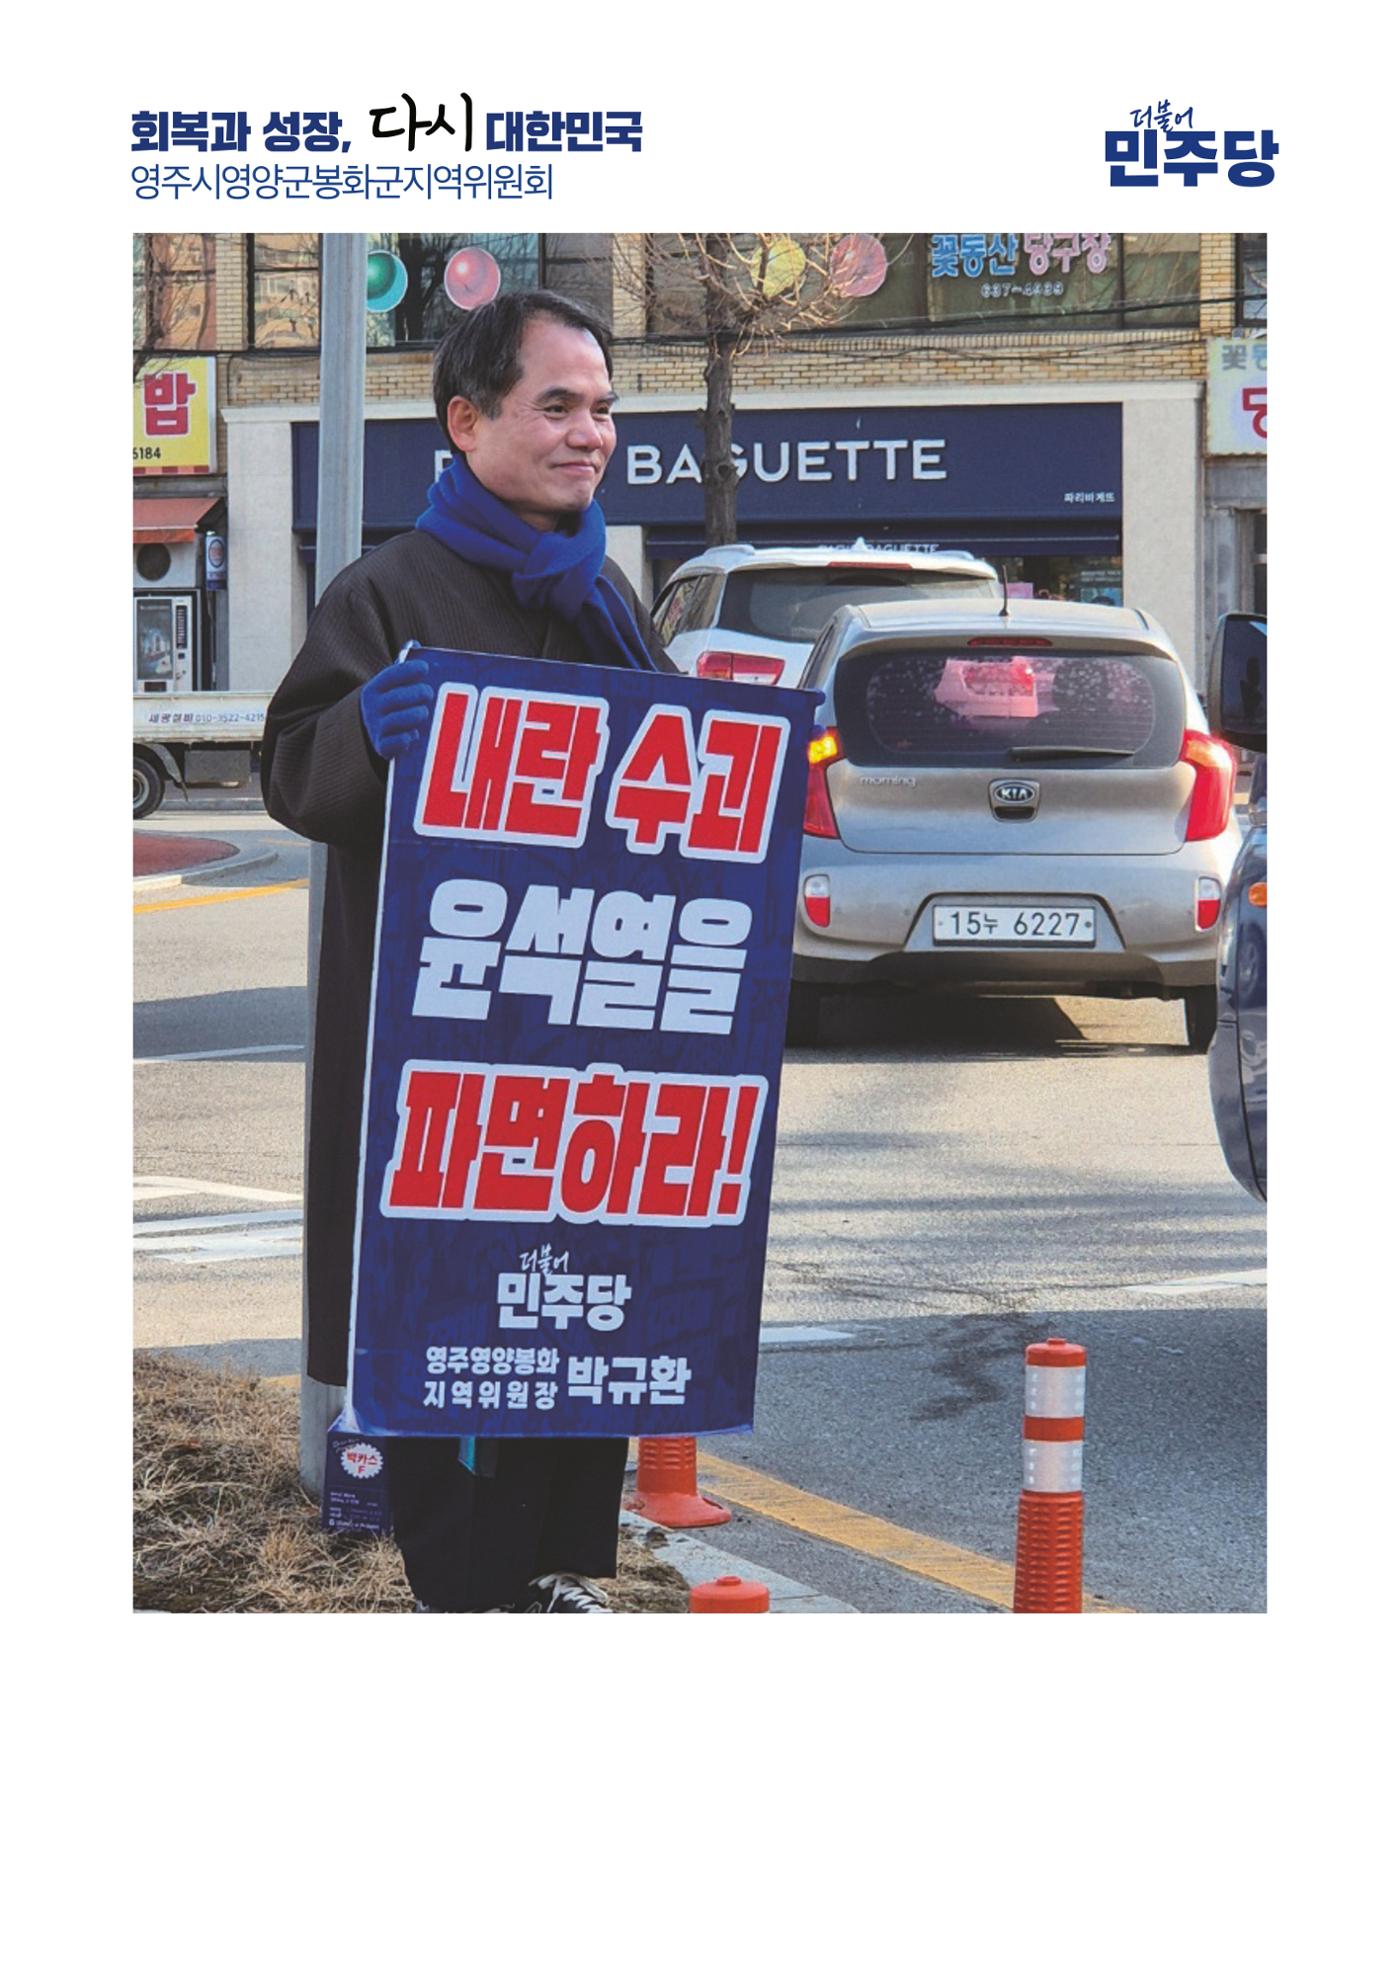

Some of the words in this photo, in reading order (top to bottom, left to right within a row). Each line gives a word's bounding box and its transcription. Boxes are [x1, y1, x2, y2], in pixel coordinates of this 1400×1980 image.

[932, 234, 1019, 277] 꽃동산
[1023, 233, 1112, 276] 당구장
[143, 371, 197, 437] 밥
[414, 682, 609, 848] 내란
[605, 704, 791, 864] 수괴
[1001, 788, 1028, 799] KIA
[951, 911, 998, 935] 15누
[1013, 912, 1080, 936] 6227
[412, 879, 752, 1035] 윤석열을
[380, 1059, 769, 1228] 파면하라!
[519, 1243, 569, 1276] 더불어
[497, 1273, 632, 1331] 민주당
[426, 1347, 559, 1374] 영주영양봉화
[567, 1355, 691, 1406] 박규환
[347, 1452, 378, 1465] 박카스
